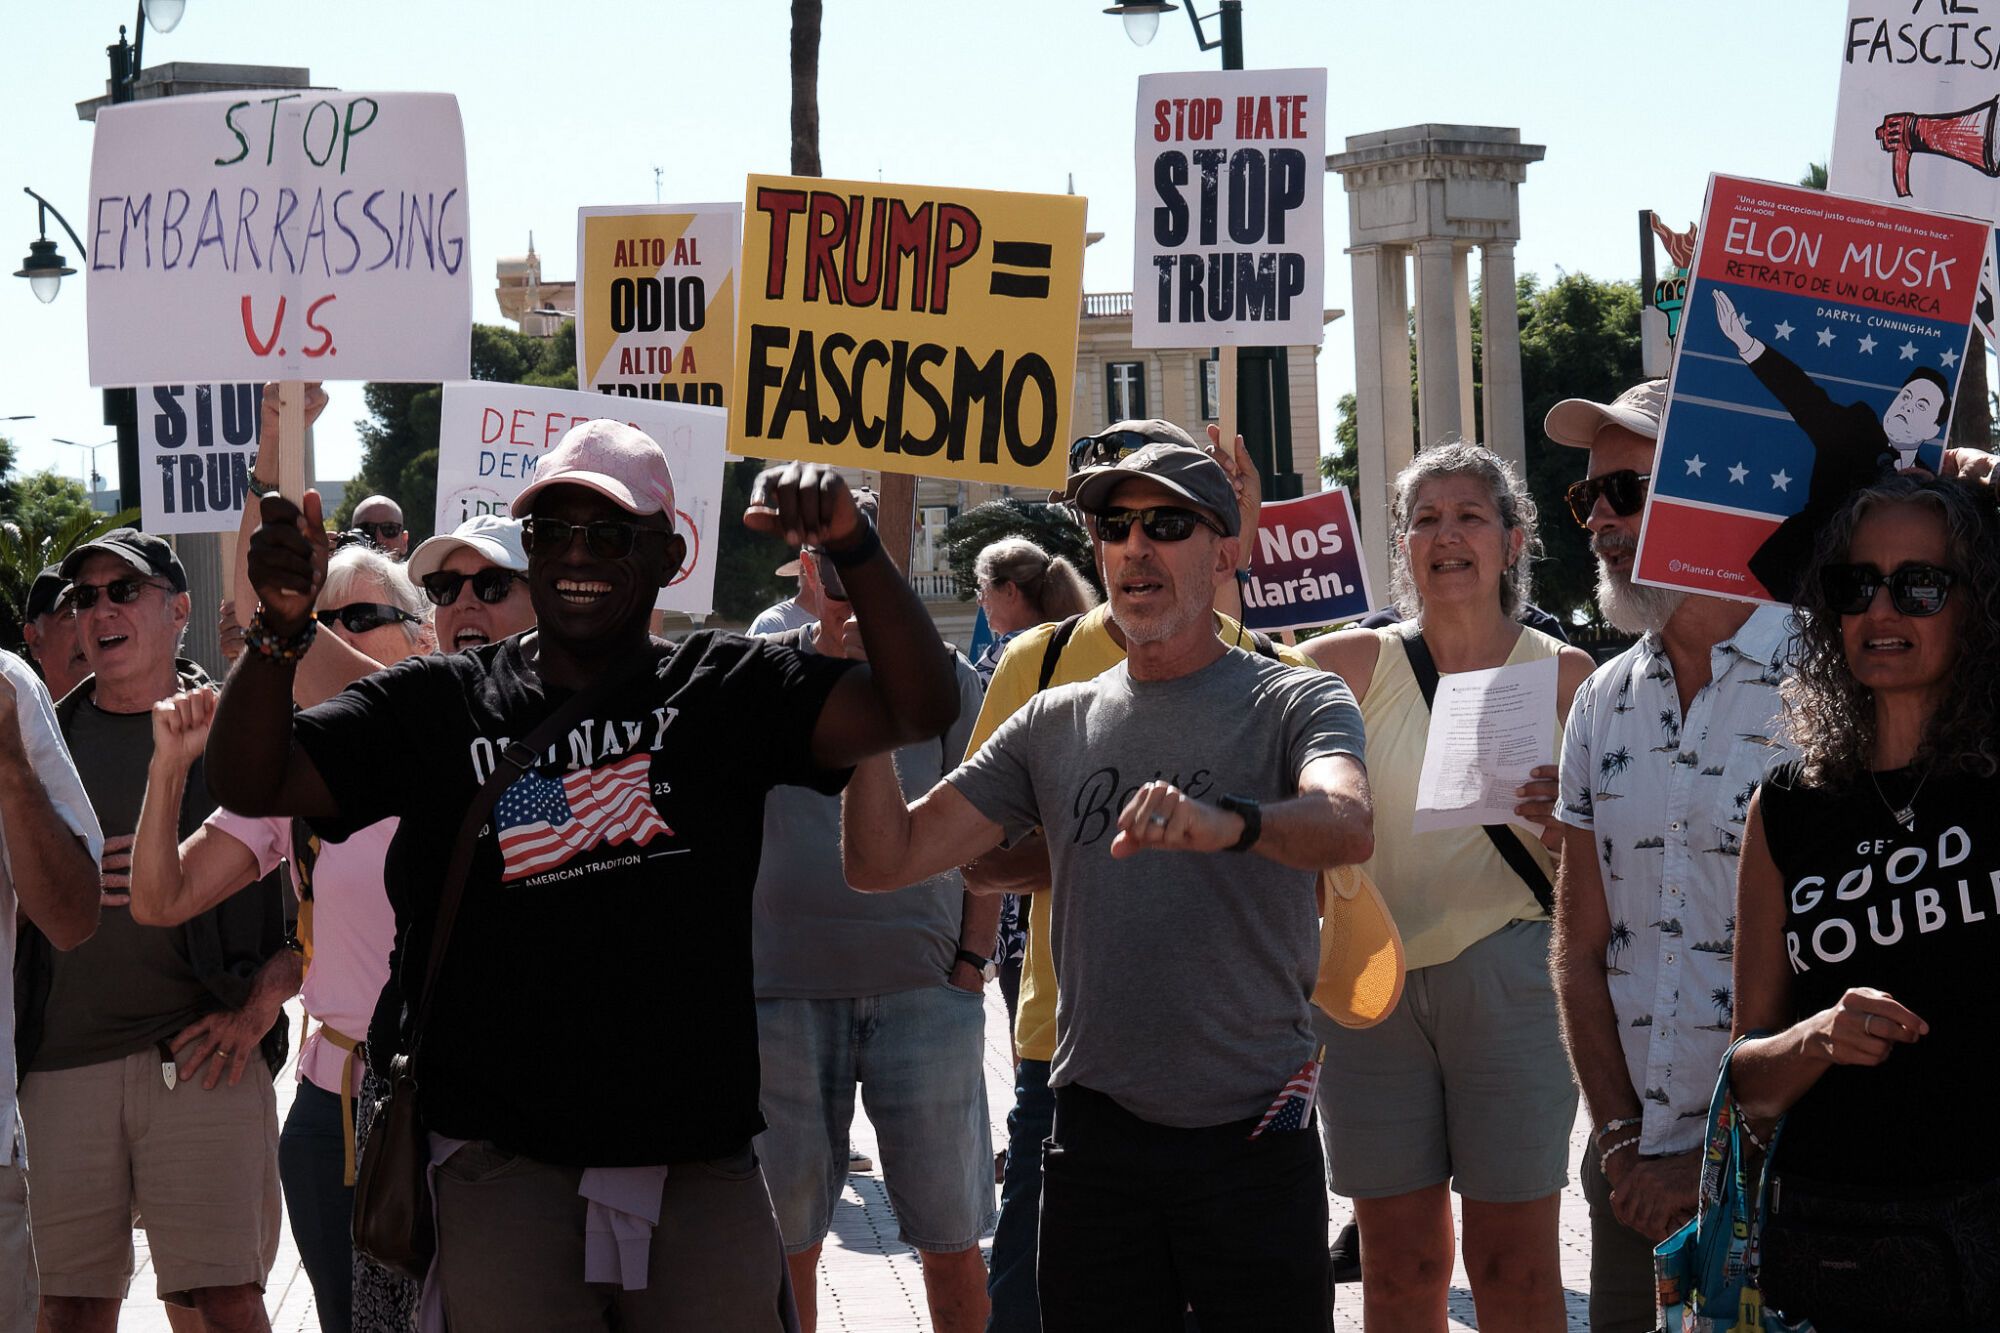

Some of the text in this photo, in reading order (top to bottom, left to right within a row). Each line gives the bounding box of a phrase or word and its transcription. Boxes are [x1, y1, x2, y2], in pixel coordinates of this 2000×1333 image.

[1846, 19, 2000, 70] FASCIS
[215, 94, 378, 174] STOP
[1154, 95, 1308, 142] STOP HATE
[1153, 147, 1306, 247] STOP
[1734, 204, 1752, 213] ALAN
[1757, 199, 1775, 209] obra
[1777, 203, 1824, 217] excepcional
[1824, 210, 1845, 221] justo
[1846, 215, 1875, 227] cuando
[1894, 223, 1912, 234] falta
[1913, 228, 1928, 237] nos
[92, 187, 463, 277] EMBARRASSING
[614, 237, 702, 268] ALTO AL
[757, 186, 981, 315] TRUMP
[1724, 217, 1957, 291] ELON MUSK
[610, 276, 706, 333] ODIO
[1153, 252, 1306, 323] TRUMP
[1725, 260, 1941, 315] RETRATO DE UN OLIGARCA
[241, 294, 337, 357] U.S.
[1816, 306, 1942, 338] DARRYL CUNNINGHAM
[619, 346, 697, 375] ALTO A
[153, 384, 264, 448] STO
[745, 323, 1058, 467] FASCISMO
[479, 451, 538, 479] DEM
[1258, 523, 1342, 565] Nos
[1244, 568, 1355, 609] llarán.
[1682, 562, 1746, 582] Planeta Cómic
[567, 707, 680, 770] NAVY
[654, 782, 671, 795] 23
[525, 854, 641, 888] AMERICAN TRADITION
[1791, 826, 1971, 915] GOOD
[1857, 838, 1894, 855] GE
